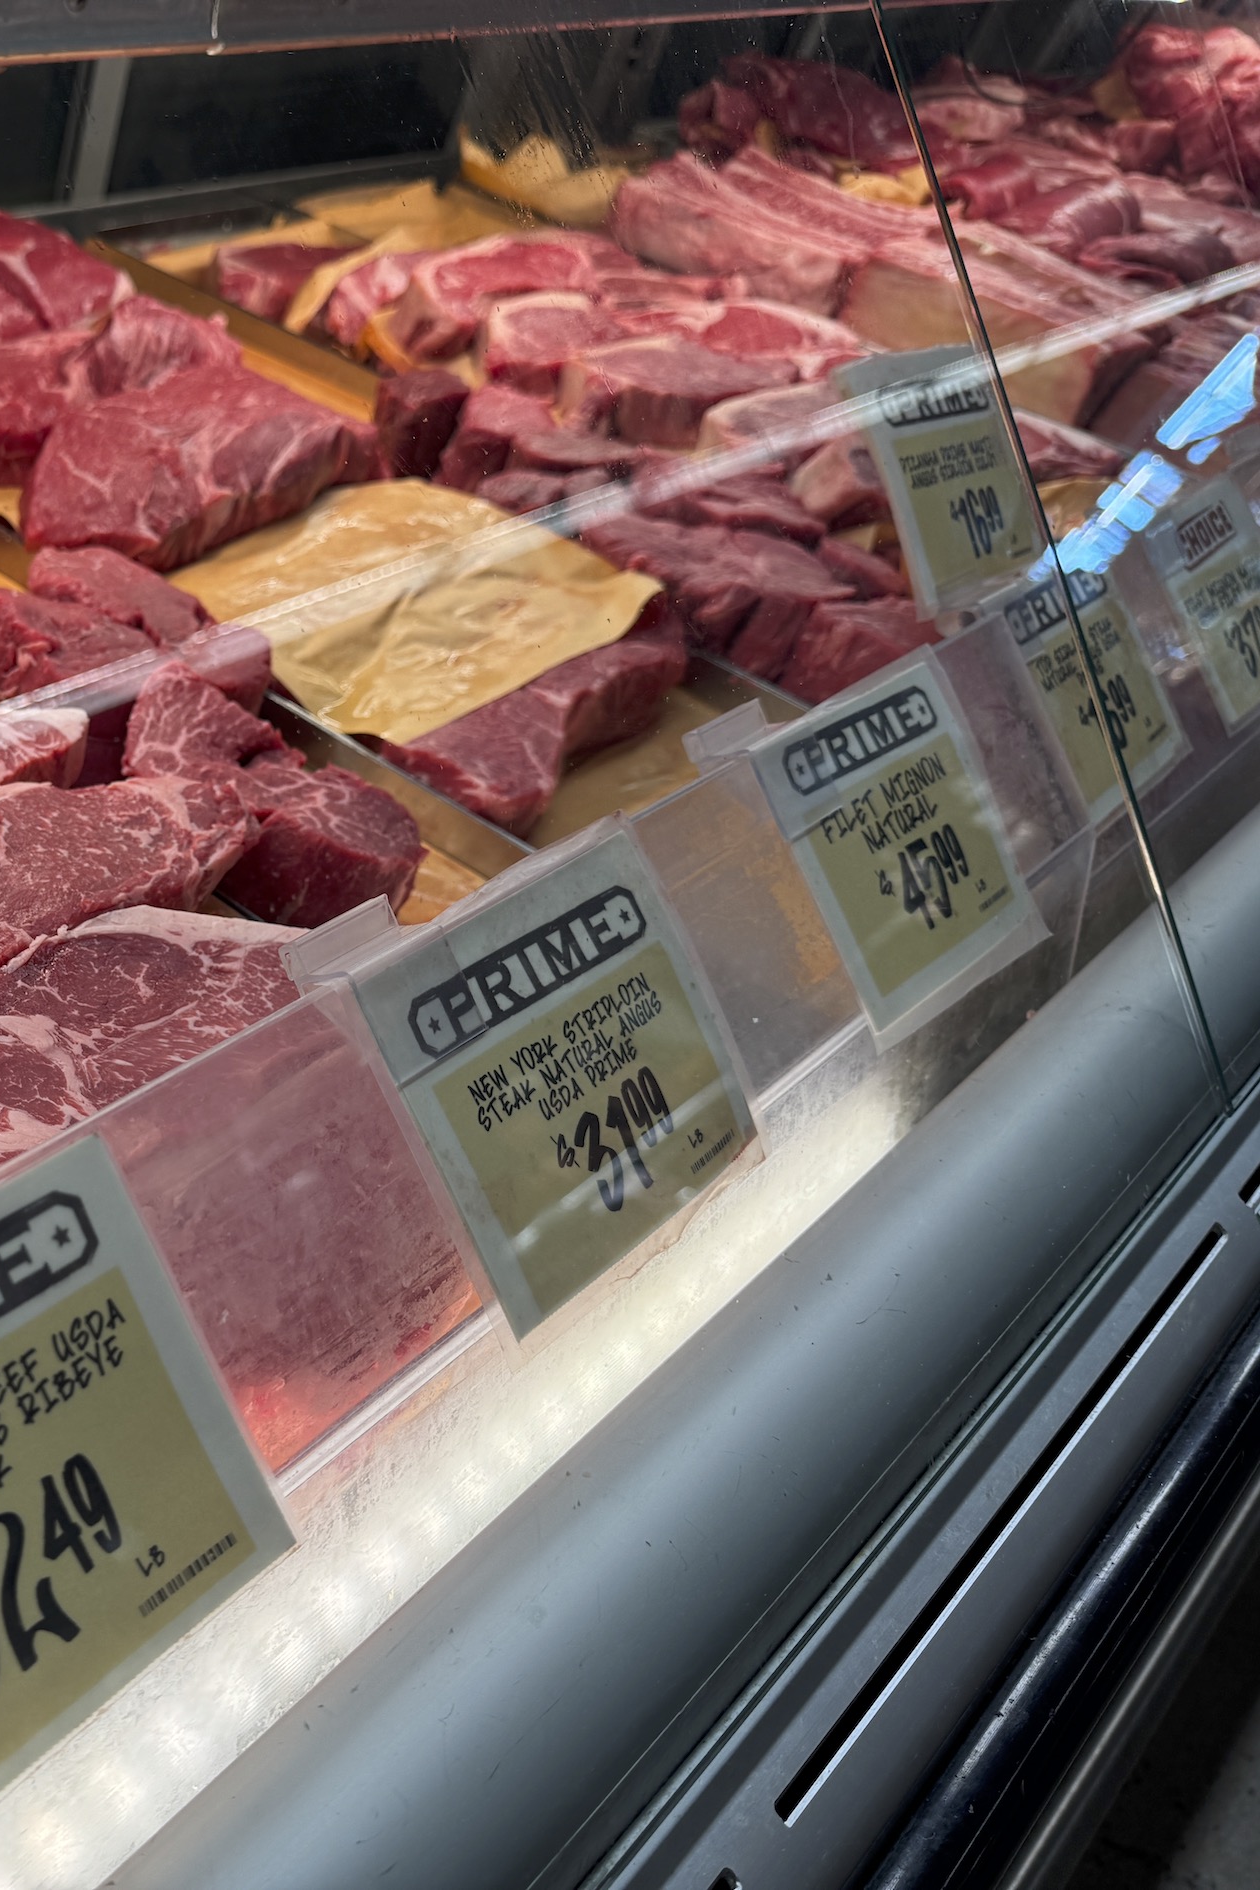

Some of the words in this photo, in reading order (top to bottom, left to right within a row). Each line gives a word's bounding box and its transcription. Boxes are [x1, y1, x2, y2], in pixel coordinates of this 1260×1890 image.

[802, 690, 926, 788] PRIME
[819, 788, 879, 845] FILET
[879, 752, 948, 809] MIGNON
[860, 794, 939, 855] NATURAL
[438, 898, 628, 1048] PRIME
[467, 1064, 510, 1106] NEW
[509, 1034, 558, 1076] YORK
[562, 972, 651, 1045] STRIPLOIN
[477, 1079, 537, 1132] STEAK
[538, 1029, 614, 1090] NATURAL
[618, 991, 662, 1038] ANGUS
[538, 1077, 586, 1121] USDA
[584, 1038, 638, 1088] PRIME
[686, 1128, 705, 1149] LB
[50, 1297, 127, 1365] USDA
[14, 1334, 126, 1427] RIBEYE
[135, 1544, 167, 1578] LB
